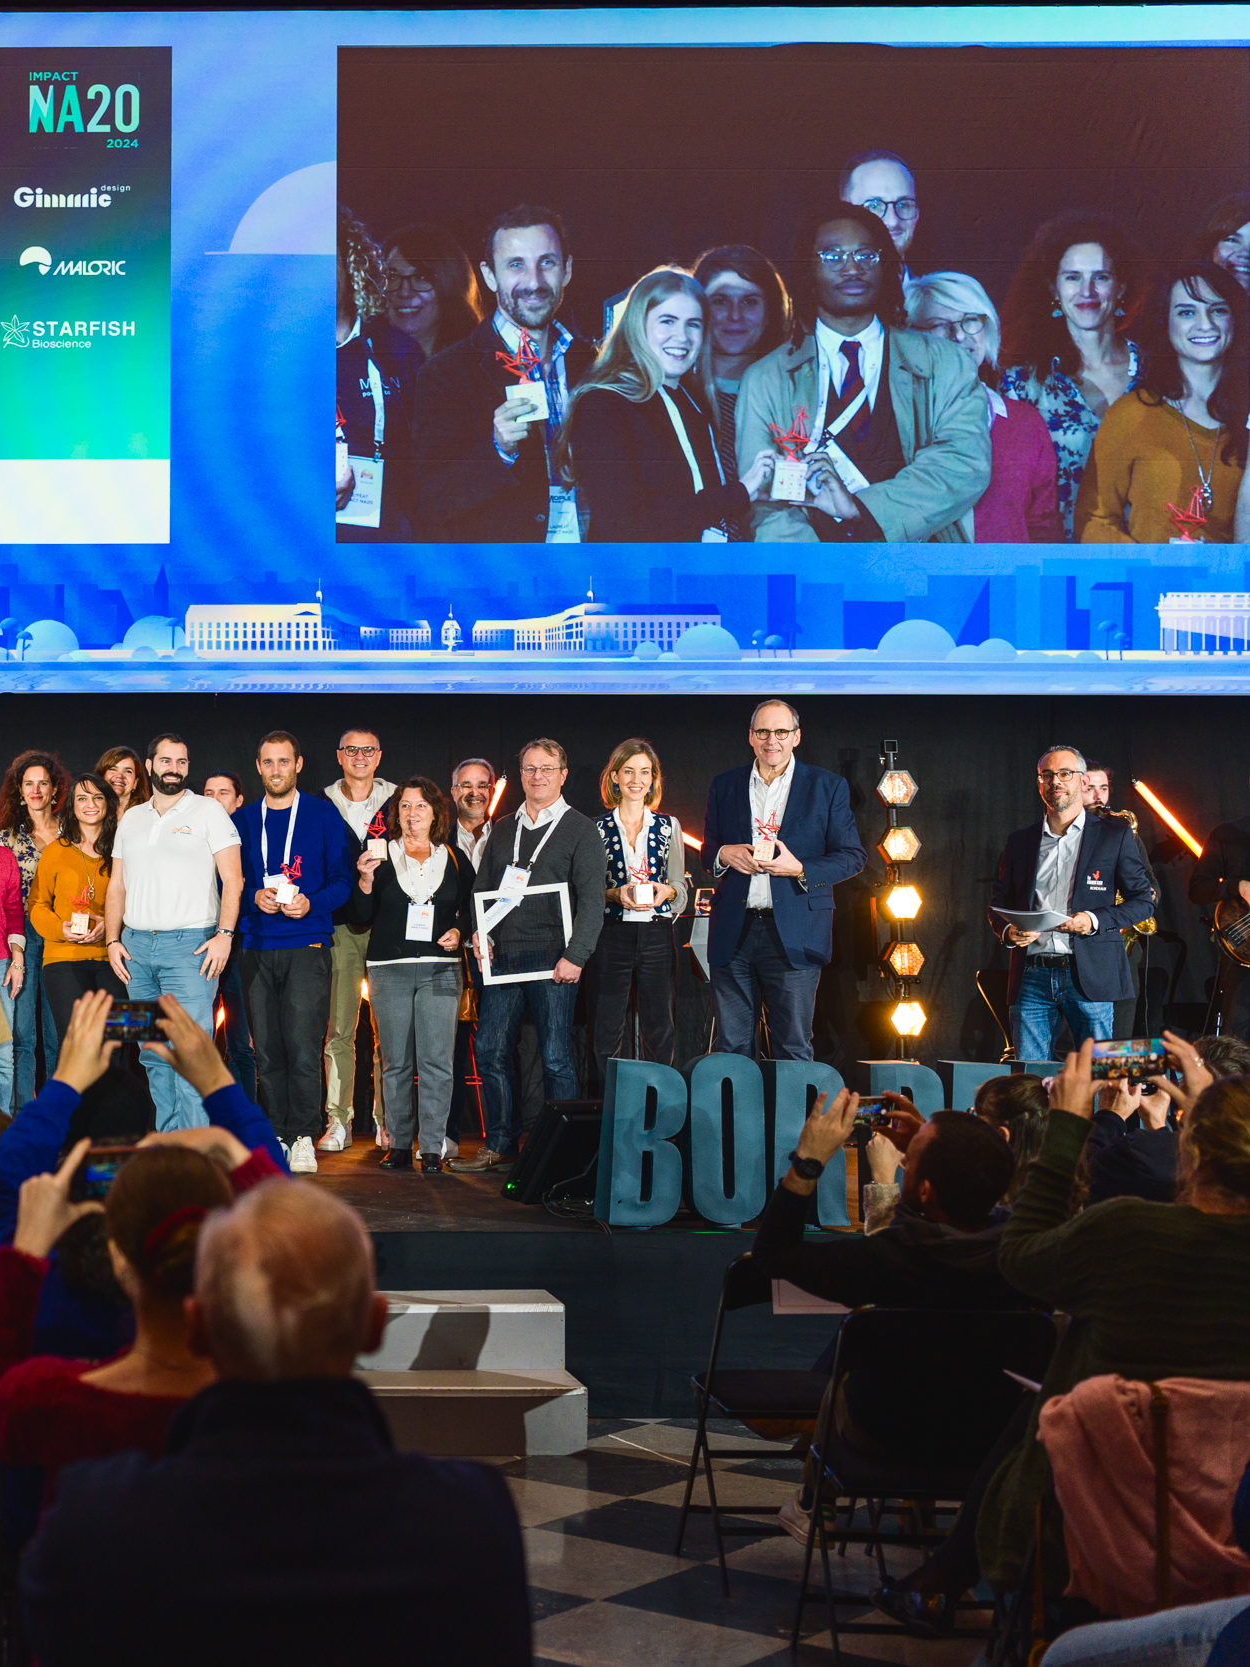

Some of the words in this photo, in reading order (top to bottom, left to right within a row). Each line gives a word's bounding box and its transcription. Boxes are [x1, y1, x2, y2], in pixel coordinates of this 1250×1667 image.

[29, 72, 79, 82] IMPACT
[29, 84, 140, 133] NA20
[106, 138, 139, 149] 2024
[100, 184, 131, 193] design
[53, 260, 126, 275] MALORIC
[32, 320, 135, 337] STARFISH
[32, 339, 92, 349] Bioscience
[359, 377, 400, 390] MN
